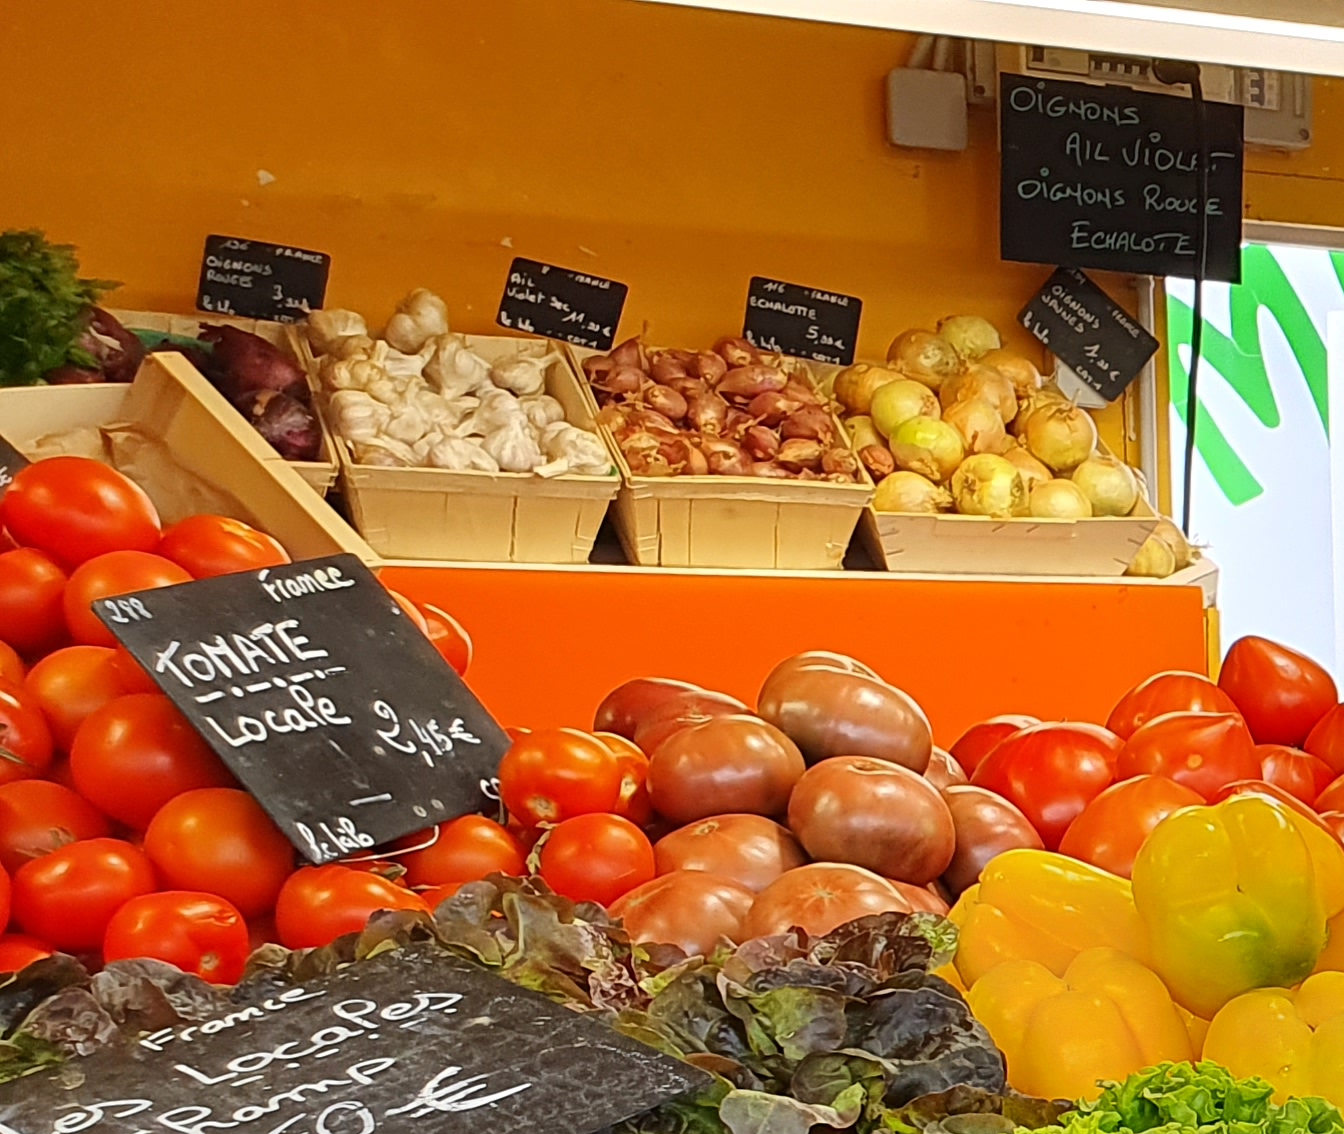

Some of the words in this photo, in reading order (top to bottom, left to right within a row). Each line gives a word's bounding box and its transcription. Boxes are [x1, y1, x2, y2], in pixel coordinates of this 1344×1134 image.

[155, 619, 329, 687] TOMATE
[204, 684, 352, 747] Locale
[138, 987, 327, 1052] France
[174, 992, 463, 1087] Locales
